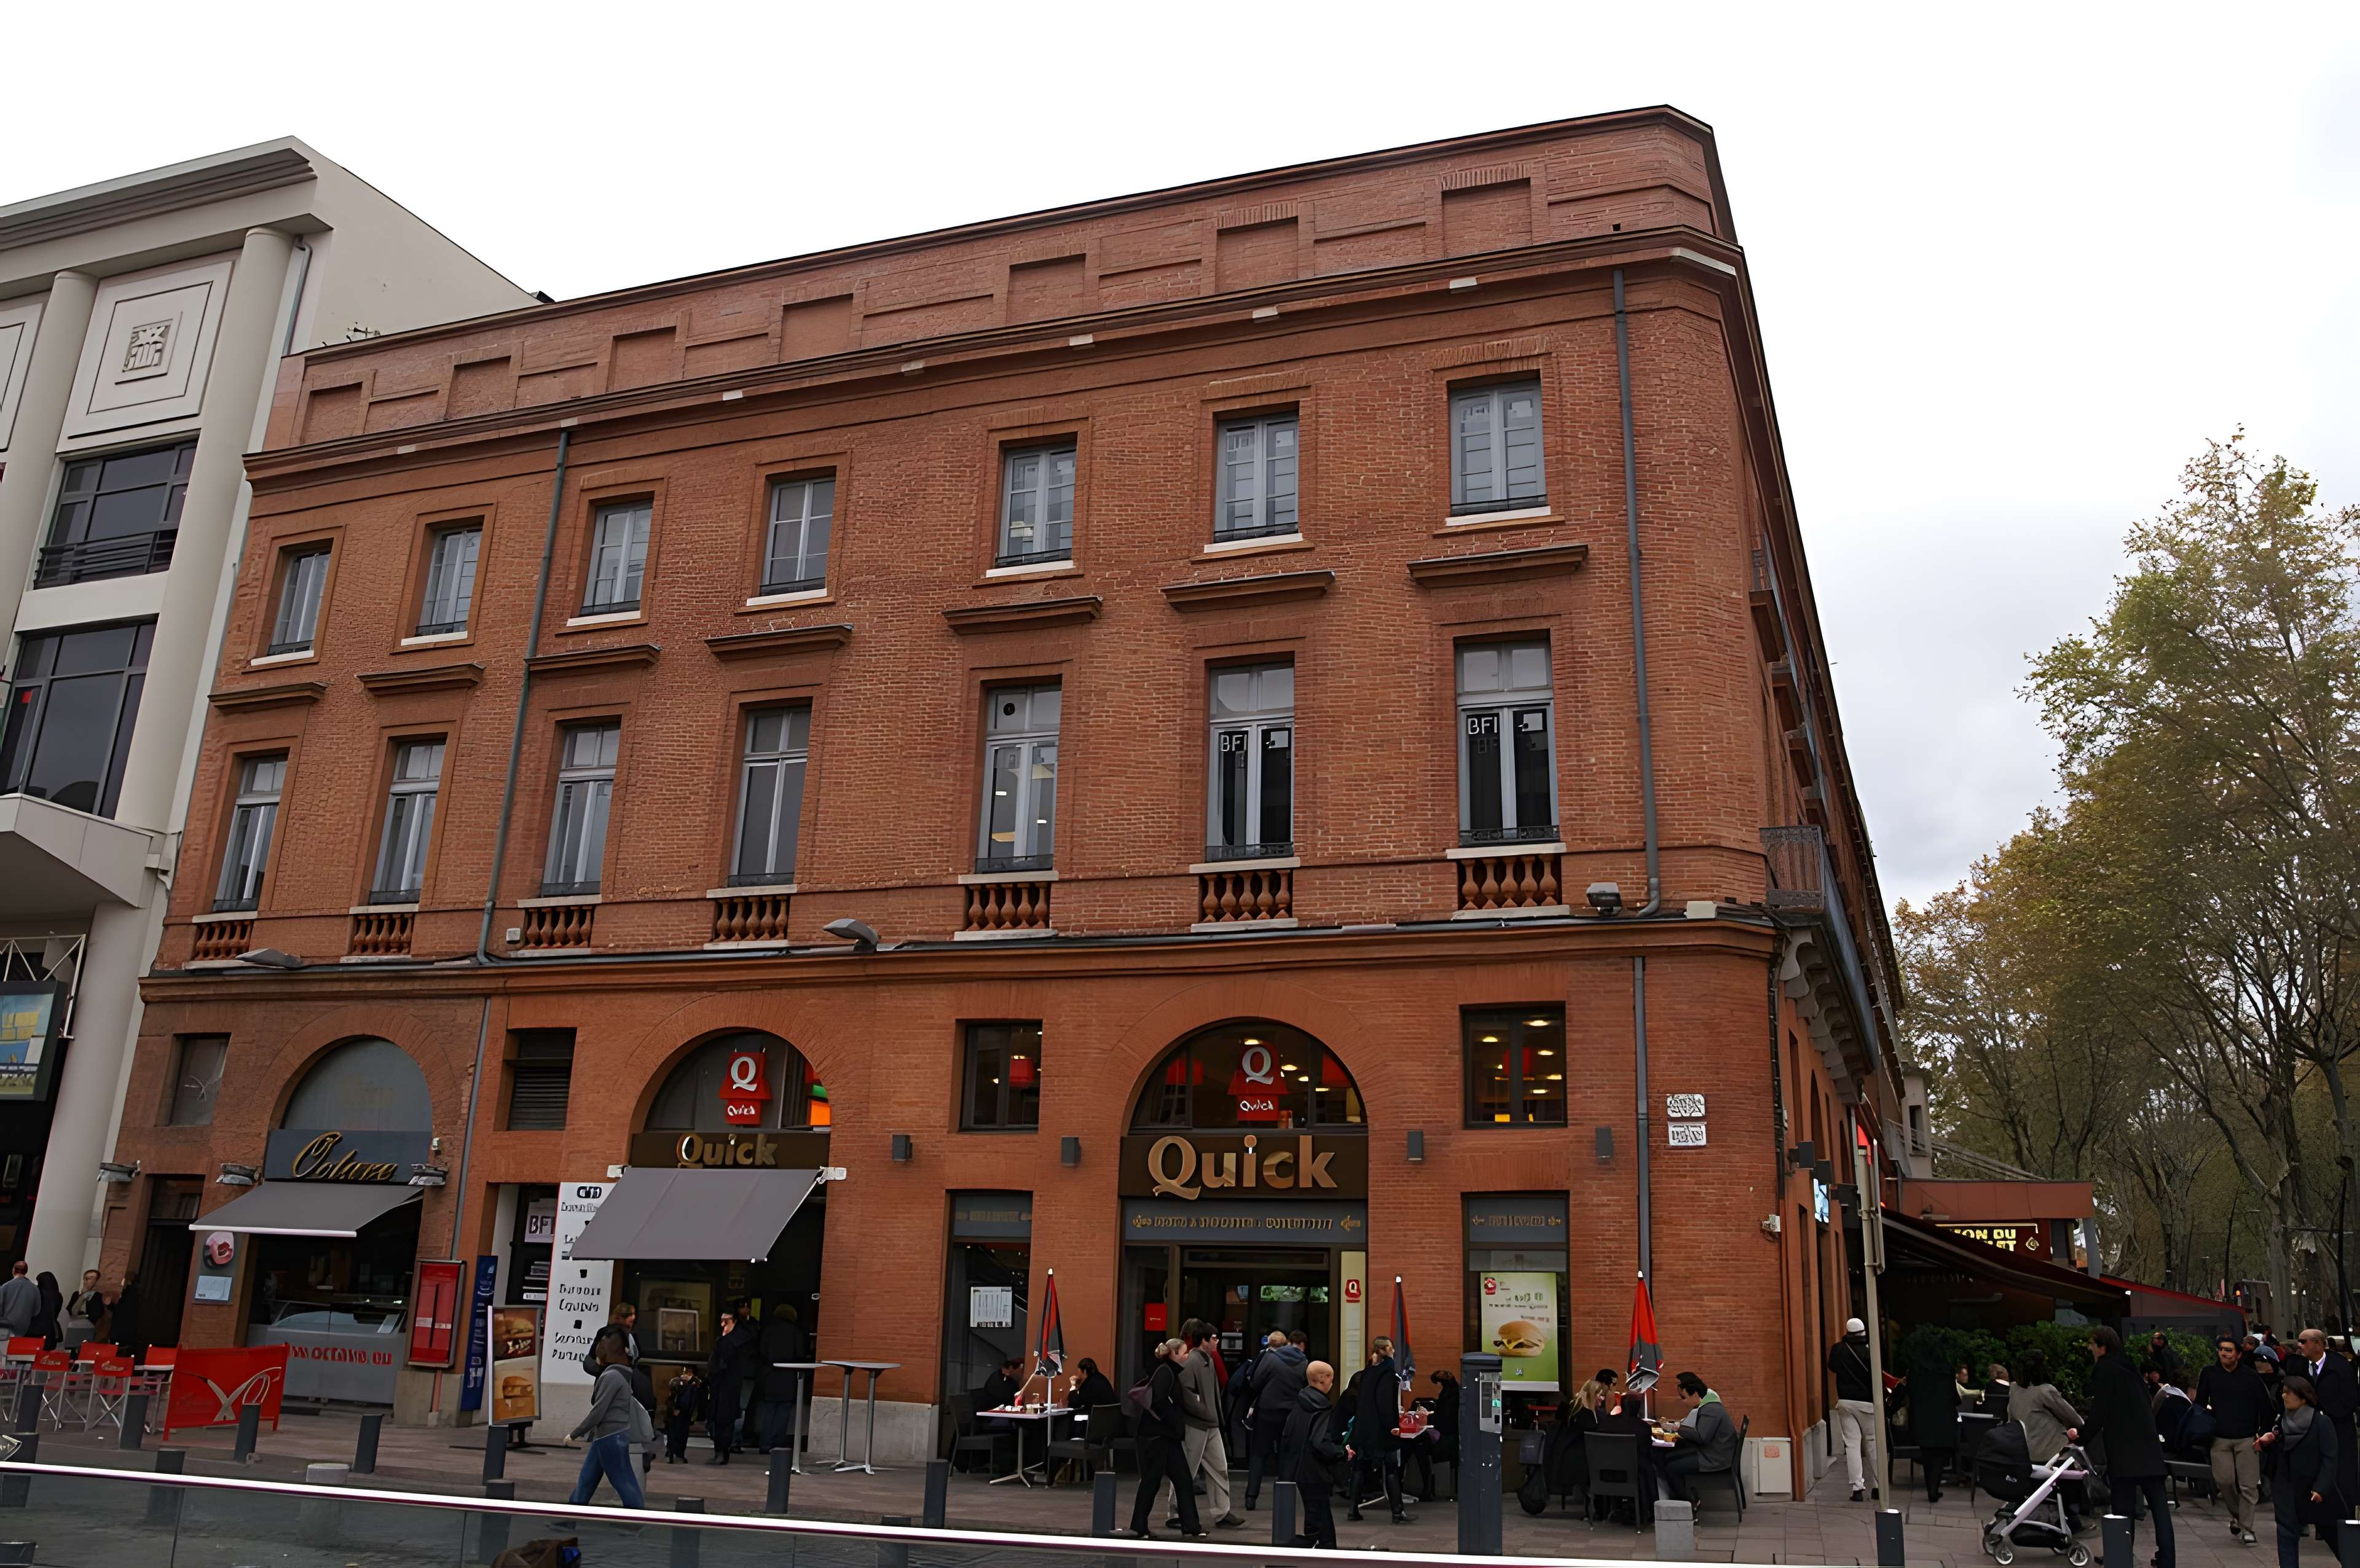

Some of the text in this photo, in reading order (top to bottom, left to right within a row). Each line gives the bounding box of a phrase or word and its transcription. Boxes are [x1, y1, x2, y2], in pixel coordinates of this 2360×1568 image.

[731, 1056, 757, 1092] Q
[1241, 1046, 1274, 1085] Q
[1240, 1099, 1274, 1111] Quick
[677, 1132, 778, 1169] Quick
[1148, 1135, 1338, 1200] Quick
[1993, 1229, 2016, 1239] DU
